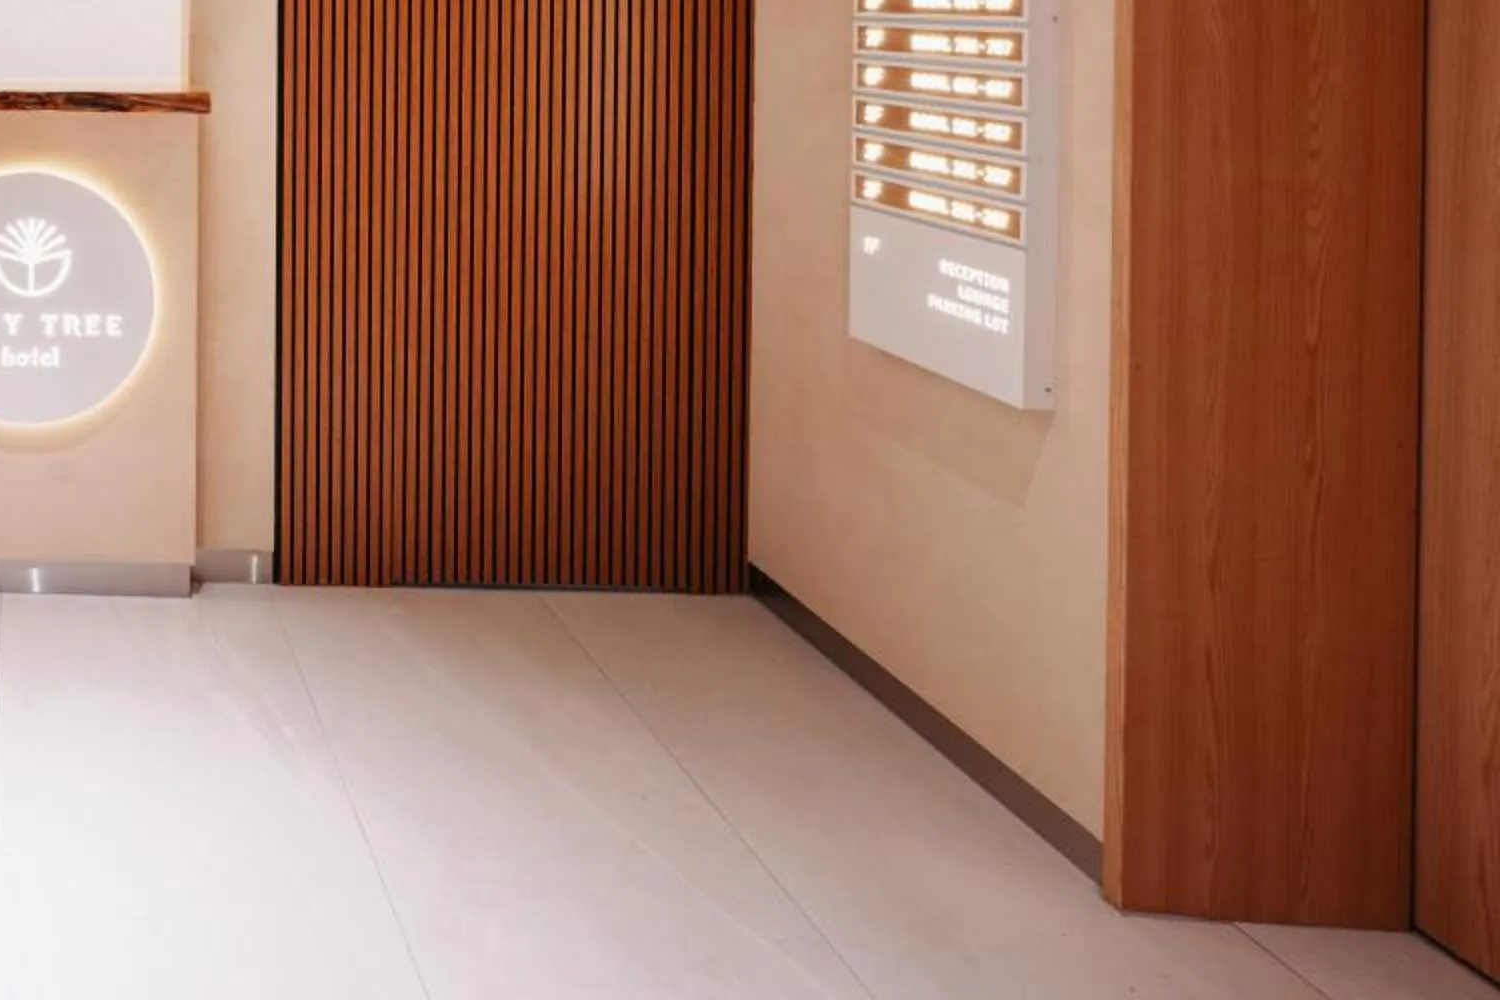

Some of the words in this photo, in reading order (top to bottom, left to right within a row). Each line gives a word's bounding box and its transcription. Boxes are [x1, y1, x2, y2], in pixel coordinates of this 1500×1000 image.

[937, 257, 1010, 293] RECEPTION
[39, 312, 124, 338] TREE
[984, 311, 1010, 335] LOT
[0, 345, 61, 369] hotel
